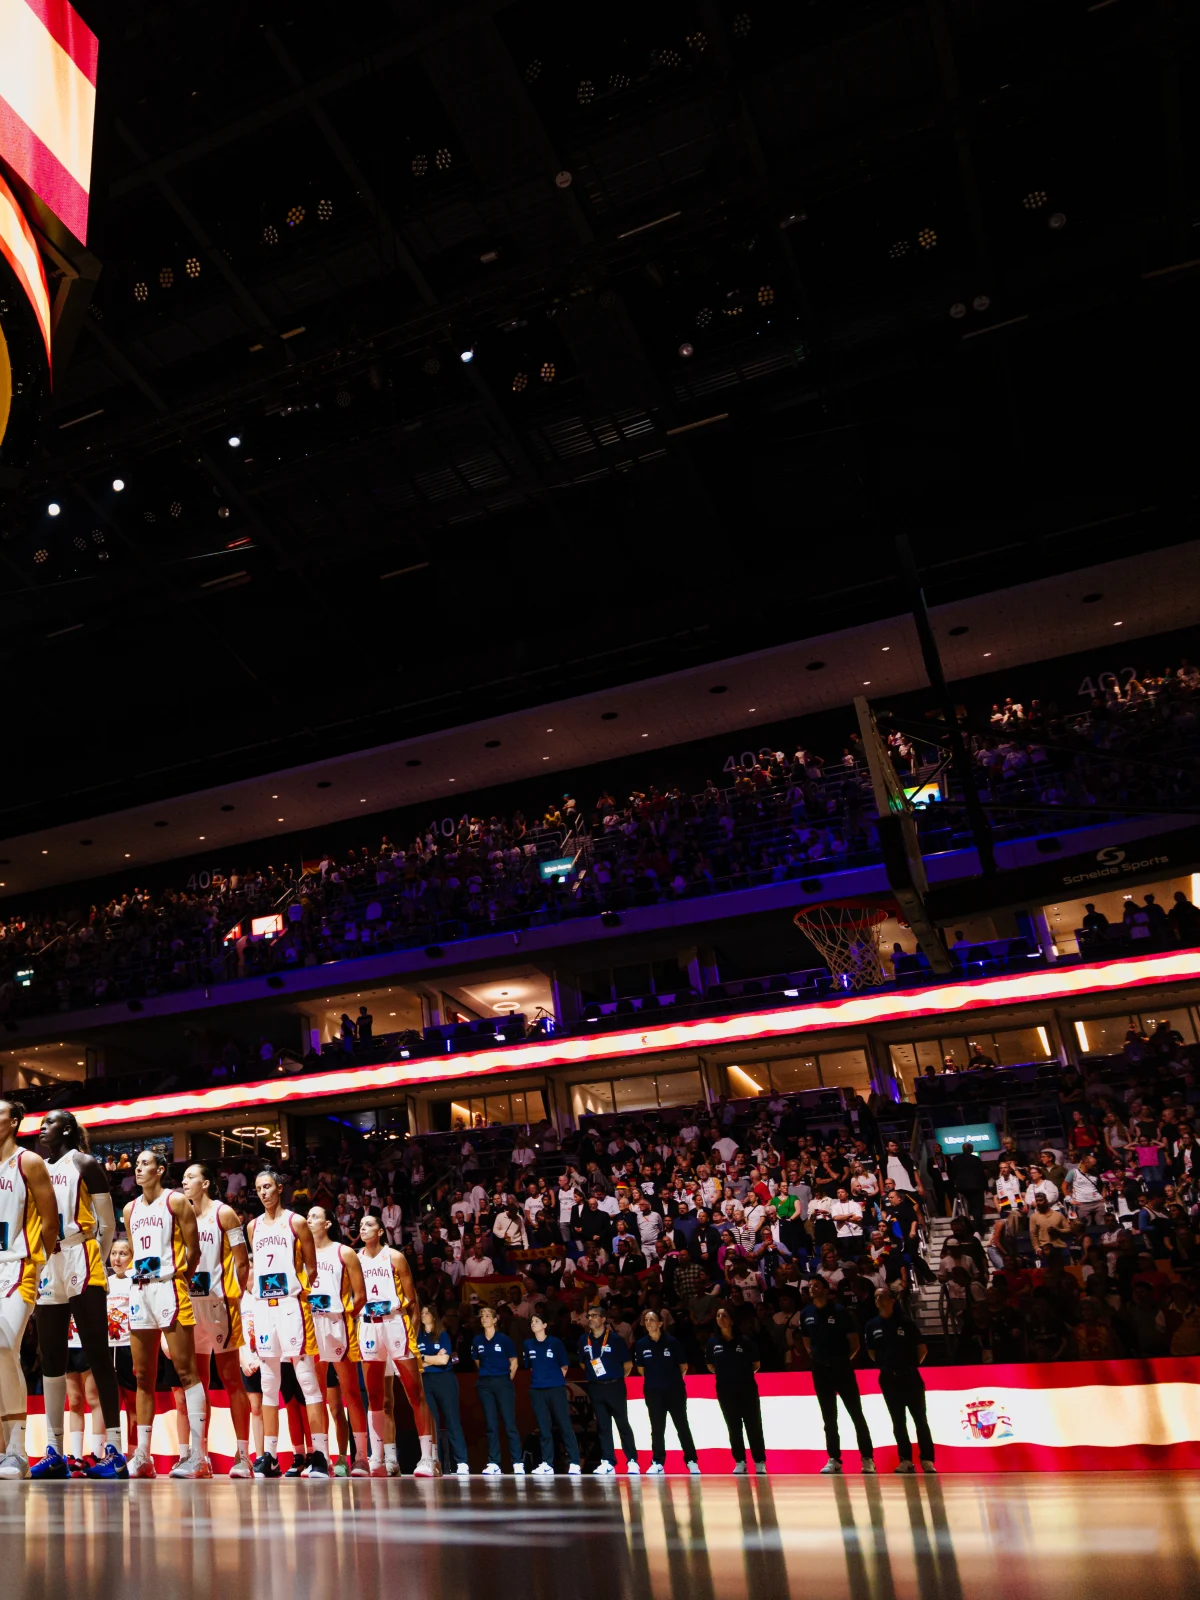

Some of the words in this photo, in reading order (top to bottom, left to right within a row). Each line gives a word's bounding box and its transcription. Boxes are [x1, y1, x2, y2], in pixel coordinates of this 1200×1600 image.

[1062, 867, 1119, 885] Schelde
[1121, 855, 1169, 872] Sports
[944, 1136, 965, 1145] Uber
[966, 1134, 990, 1143] Arena
[140, 1235, 151, 1250] 10
[256, 1235, 288, 1252] ESPAÑA
[266, 1254, 274, 1268] 7
[371, 1284, 379, 1296] 4
